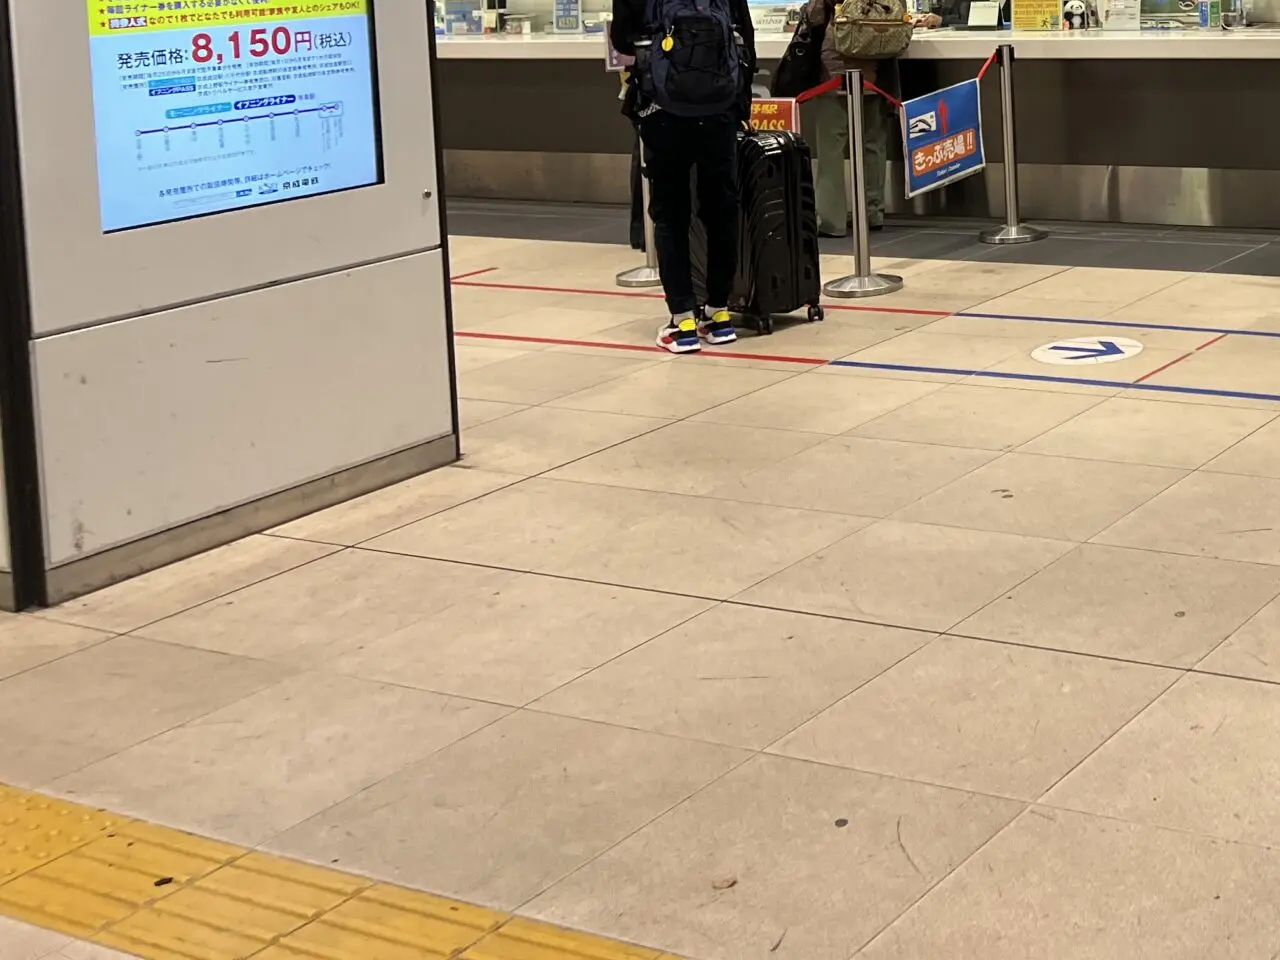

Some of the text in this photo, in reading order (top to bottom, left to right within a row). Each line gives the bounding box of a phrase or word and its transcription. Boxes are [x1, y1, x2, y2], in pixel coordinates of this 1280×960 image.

[913, 129, 974, 172] きっぷ売場!!
